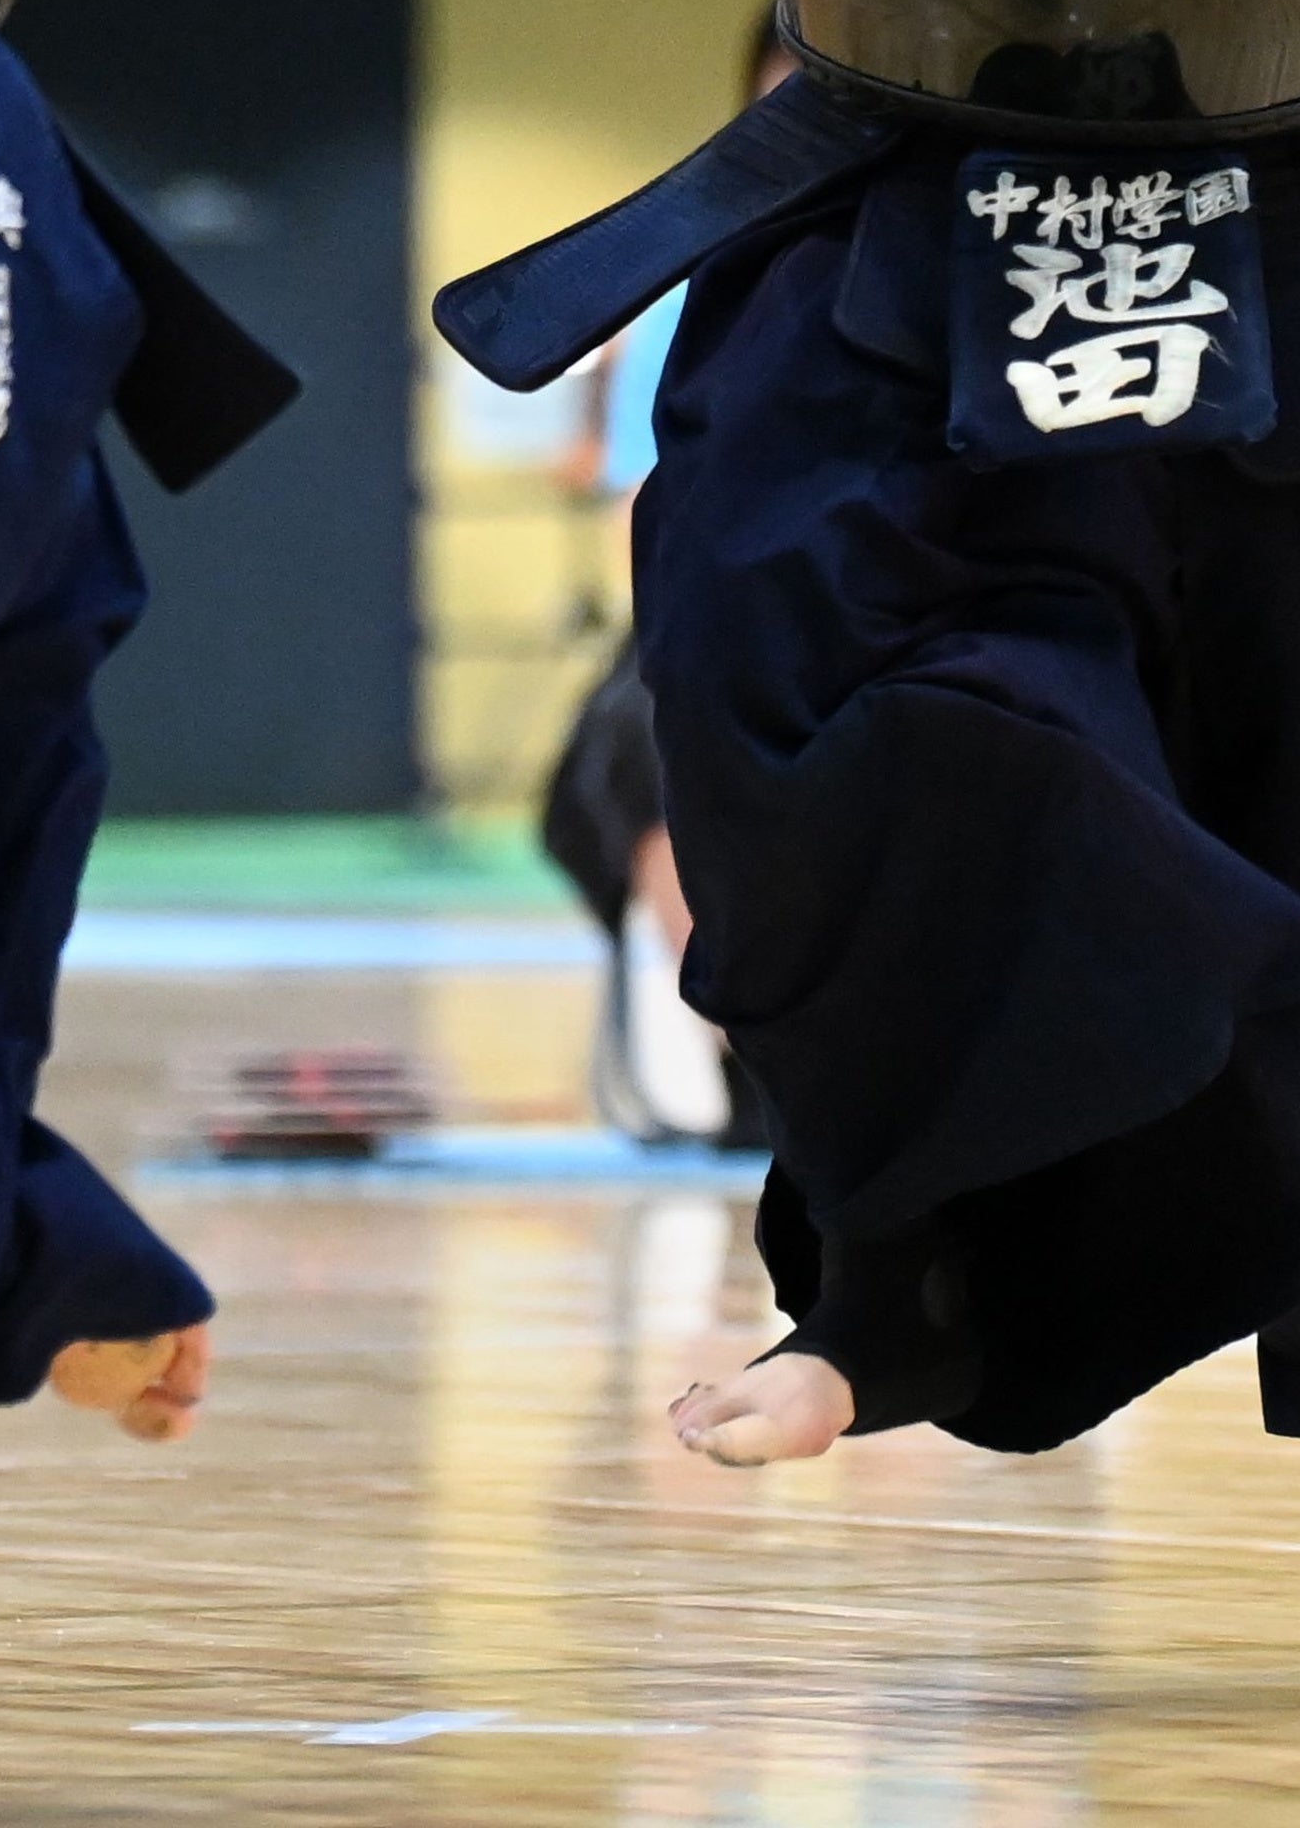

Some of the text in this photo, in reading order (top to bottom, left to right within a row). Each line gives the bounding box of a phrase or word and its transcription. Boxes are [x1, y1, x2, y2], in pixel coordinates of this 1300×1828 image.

[967, 166, 1250, 249] 中村学園
[1004, 242, 1229, 434] 池田
